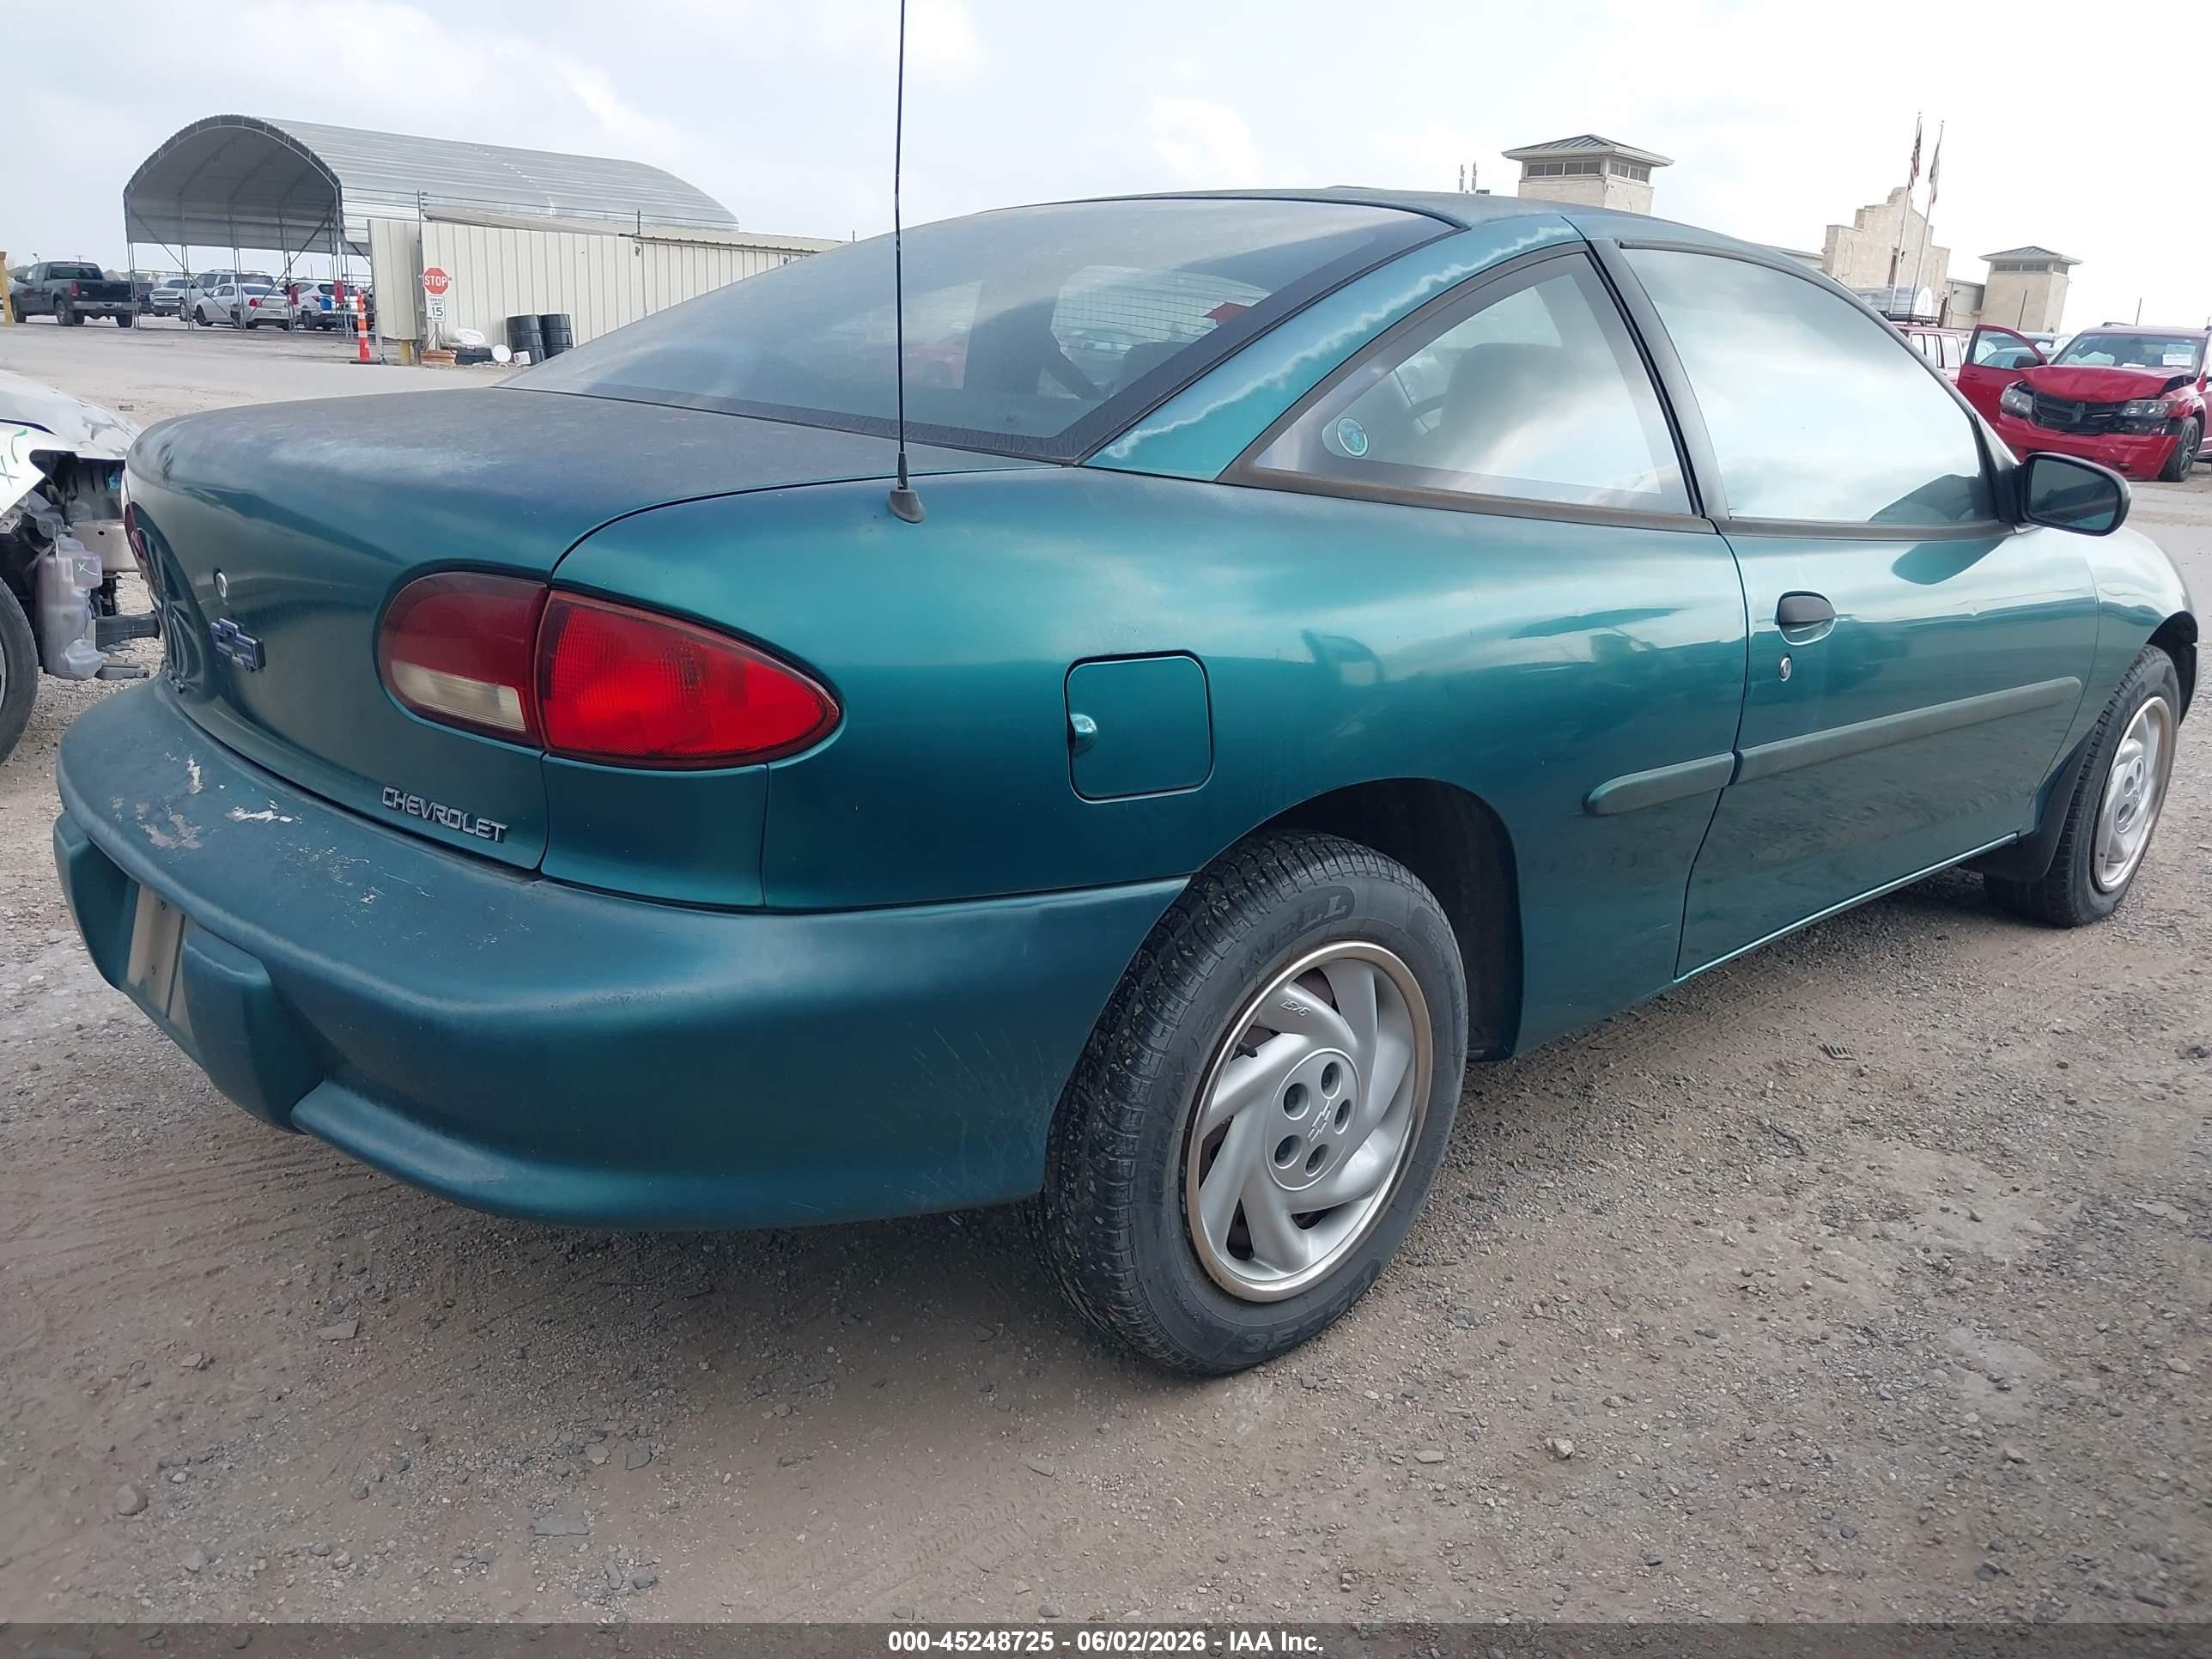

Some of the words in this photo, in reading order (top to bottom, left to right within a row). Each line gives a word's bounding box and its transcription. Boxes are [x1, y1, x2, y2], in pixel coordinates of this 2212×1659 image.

[424, 275, 447, 287] STOP
[431, 307, 444, 317] 15
[382, 787, 508, 842] CHEVROLET
